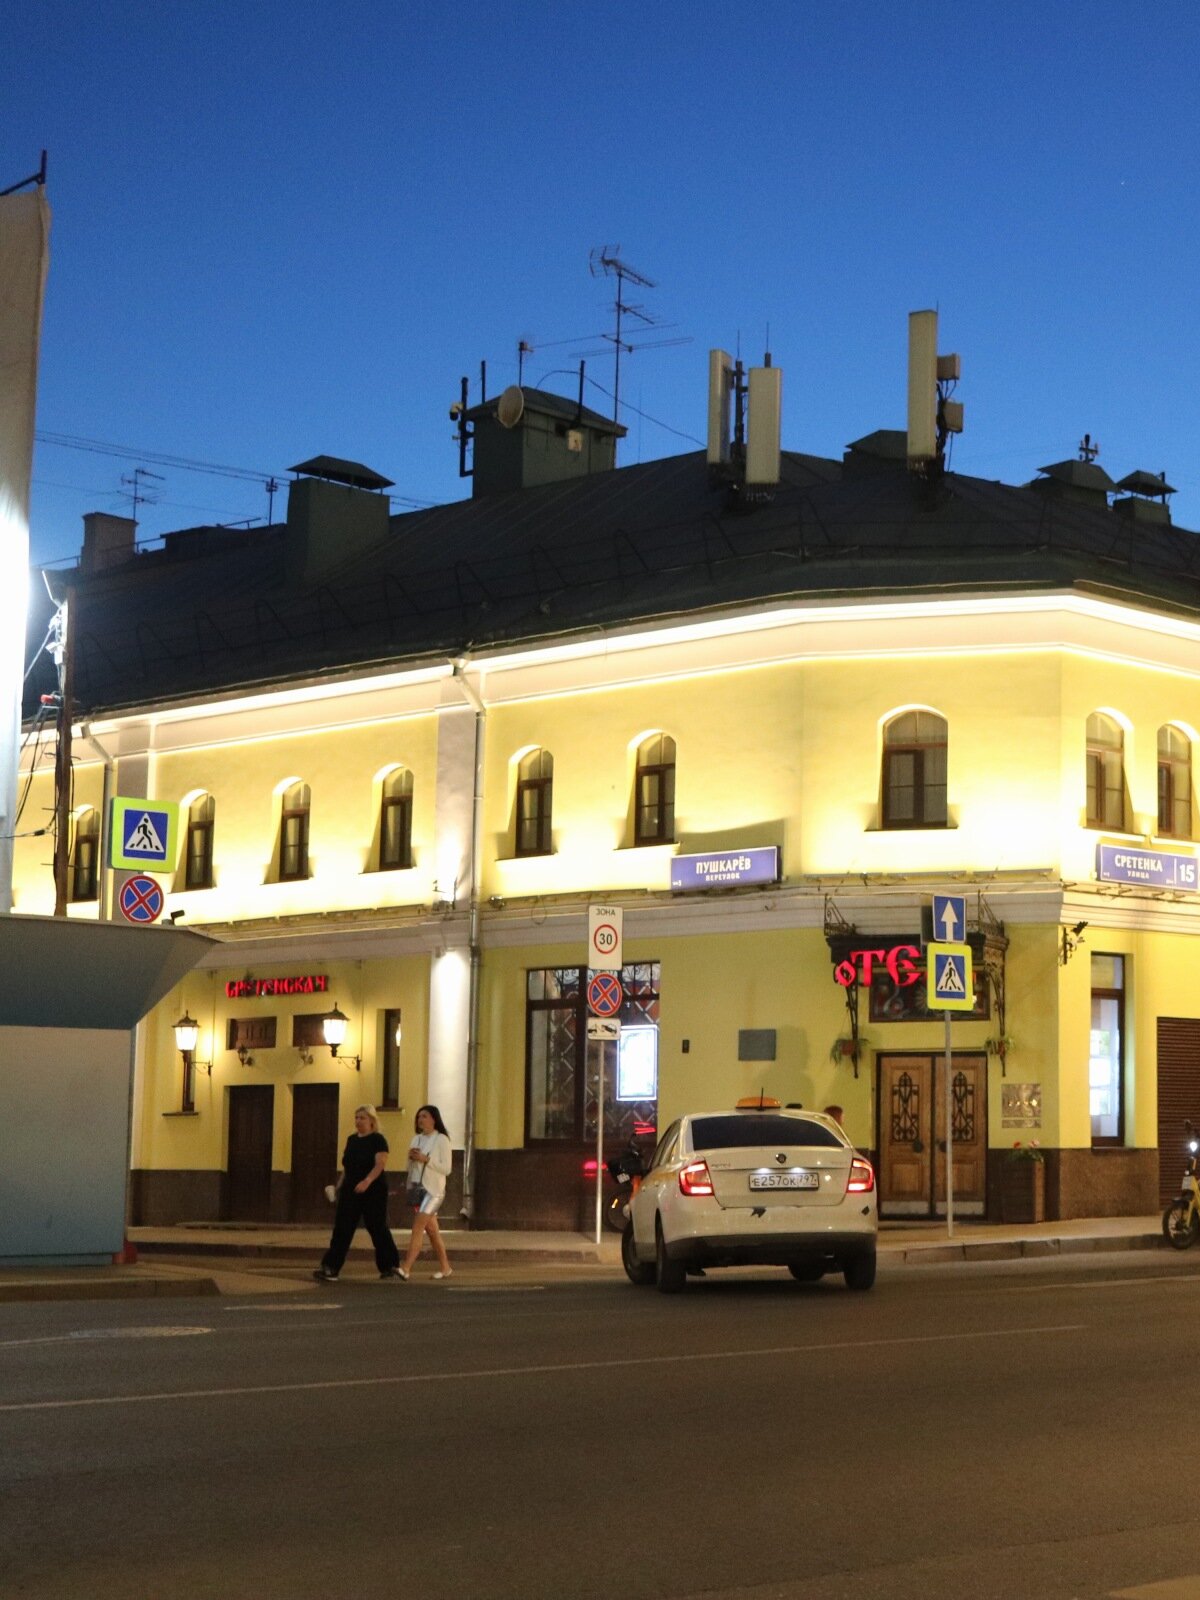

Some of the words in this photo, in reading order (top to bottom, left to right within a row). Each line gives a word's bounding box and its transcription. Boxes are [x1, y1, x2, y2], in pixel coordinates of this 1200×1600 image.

[696, 856, 751, 874] ПУШКАРЁВ
[1114, 855, 1163, 873] СРЕТЕНКА
[1179, 864, 1195, 883] 15
[705, 872, 740, 881] ПЕРЕУЛОК
[1127, 871, 1150, 879] УЛИЦА
[596, 908, 616, 916] ЗОНА
[599, 933, 613, 945] 30
